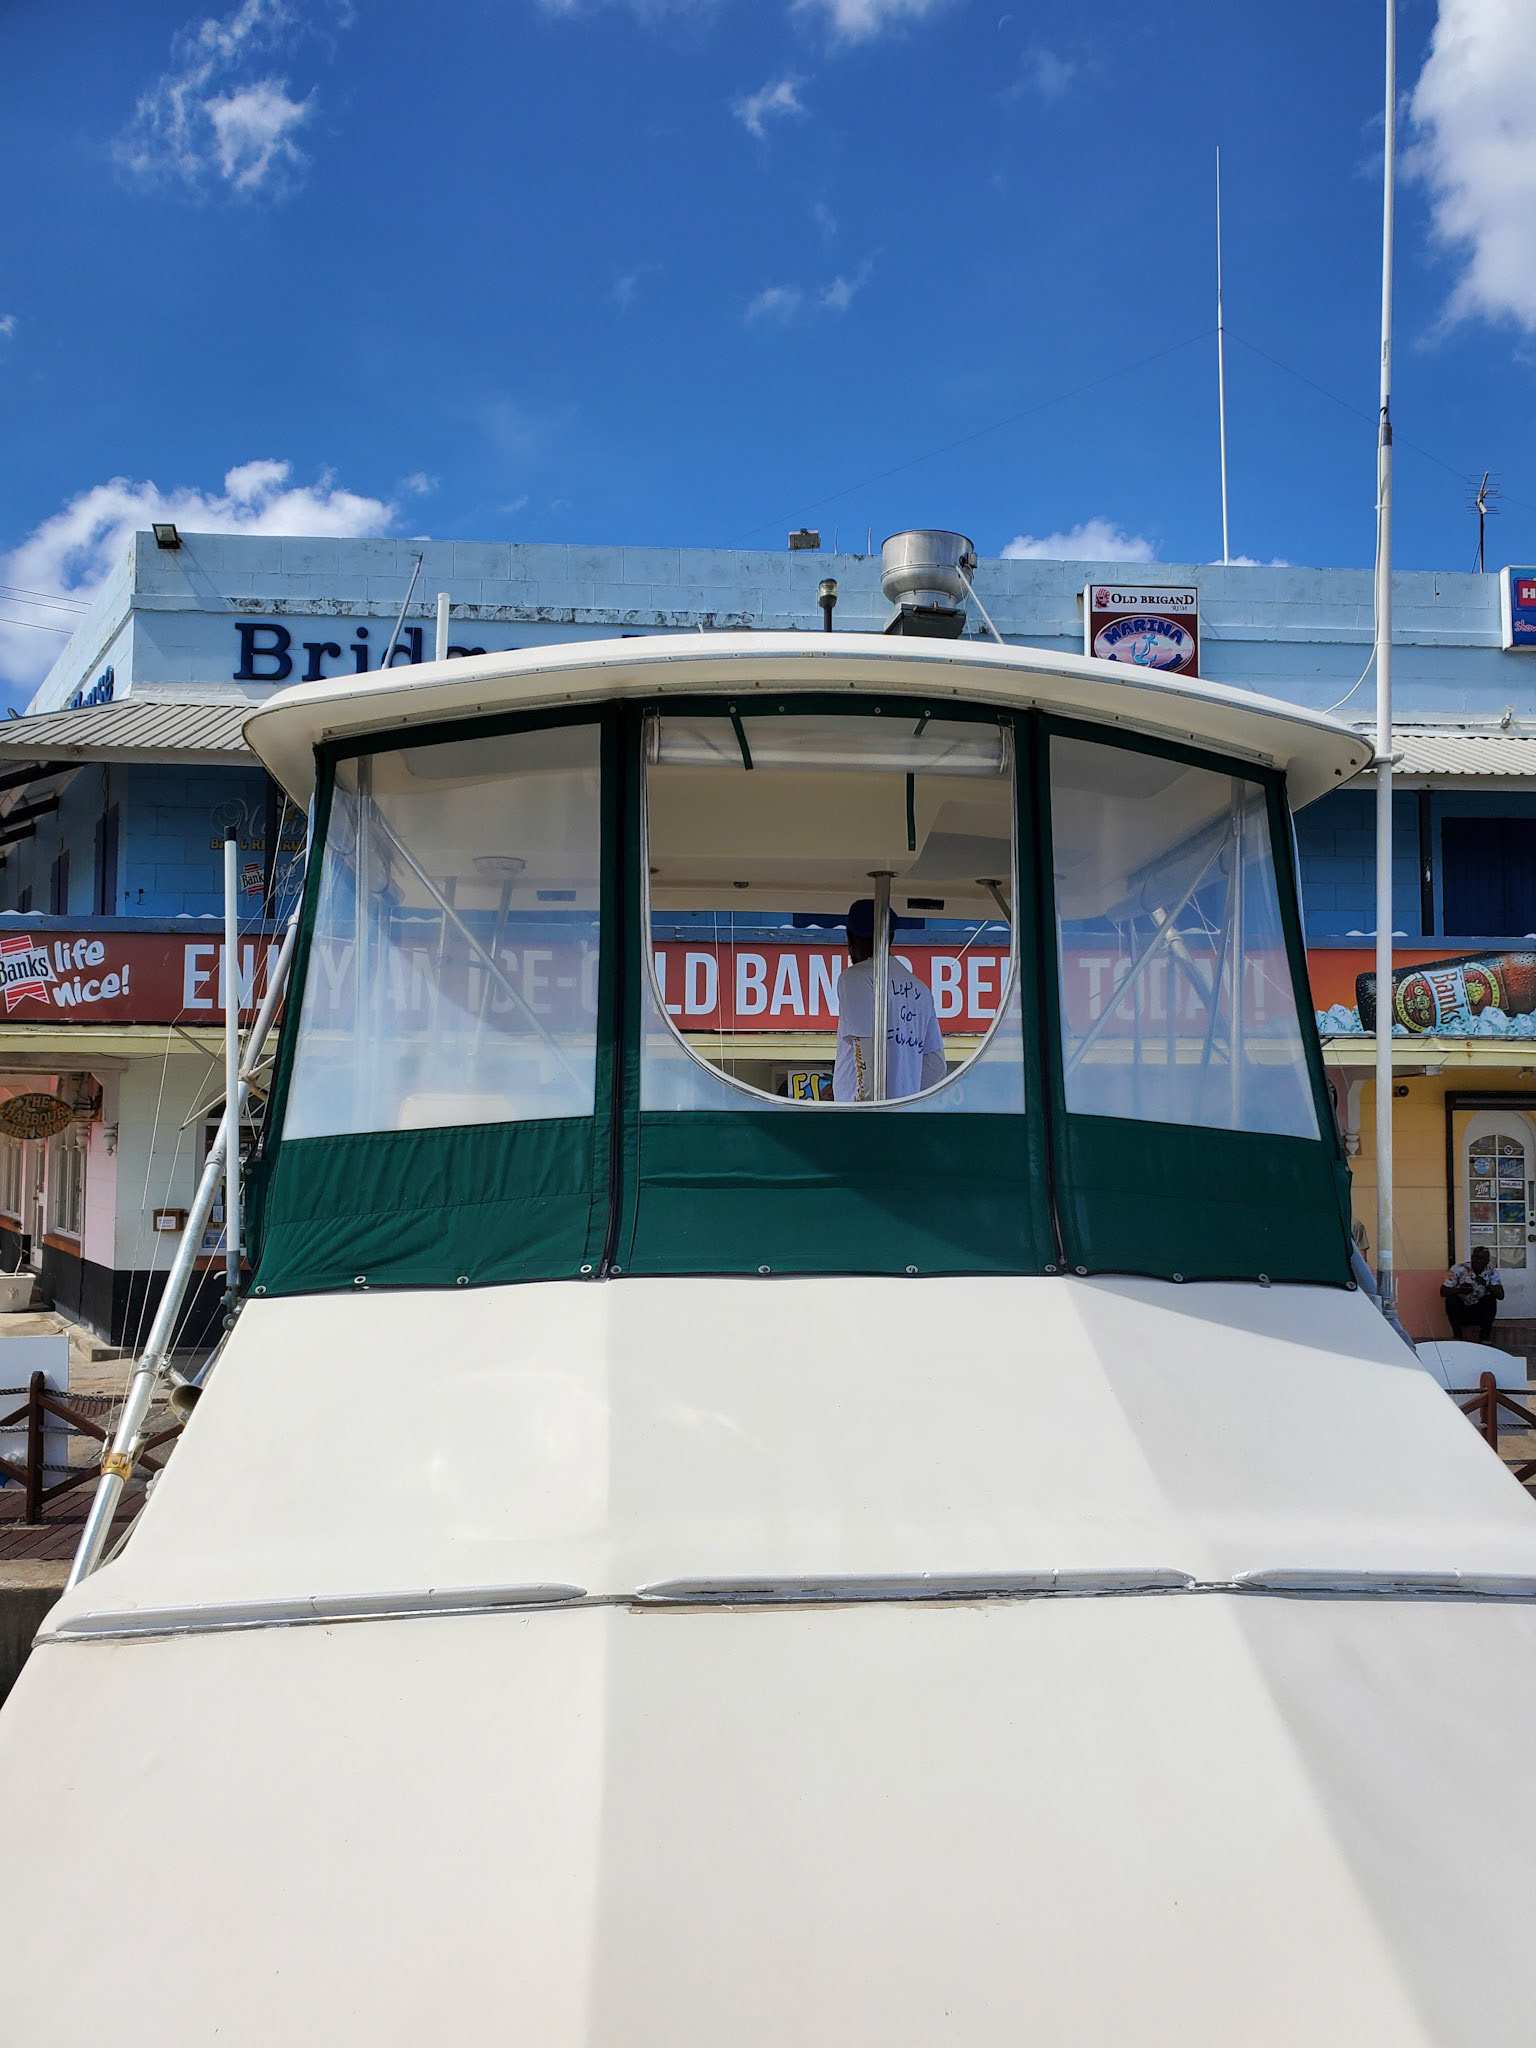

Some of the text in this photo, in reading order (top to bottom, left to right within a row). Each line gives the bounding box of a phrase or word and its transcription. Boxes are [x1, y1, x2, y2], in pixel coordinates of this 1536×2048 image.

[1111, 593, 1194, 605] OLD BRIGAND
[1103, 618, 1185, 647] MARINA
[54, 938, 105, 972] life
[52, 964, 130, 1007] nice!
[892, 980, 921, 1000] Let's
[1428, 971, 1466, 1025] Banks
[900, 1005, 917, 1021] Go
[24, 1096, 50, 1108] THE
[6, 1103, 67, 1125] HARBOUR
